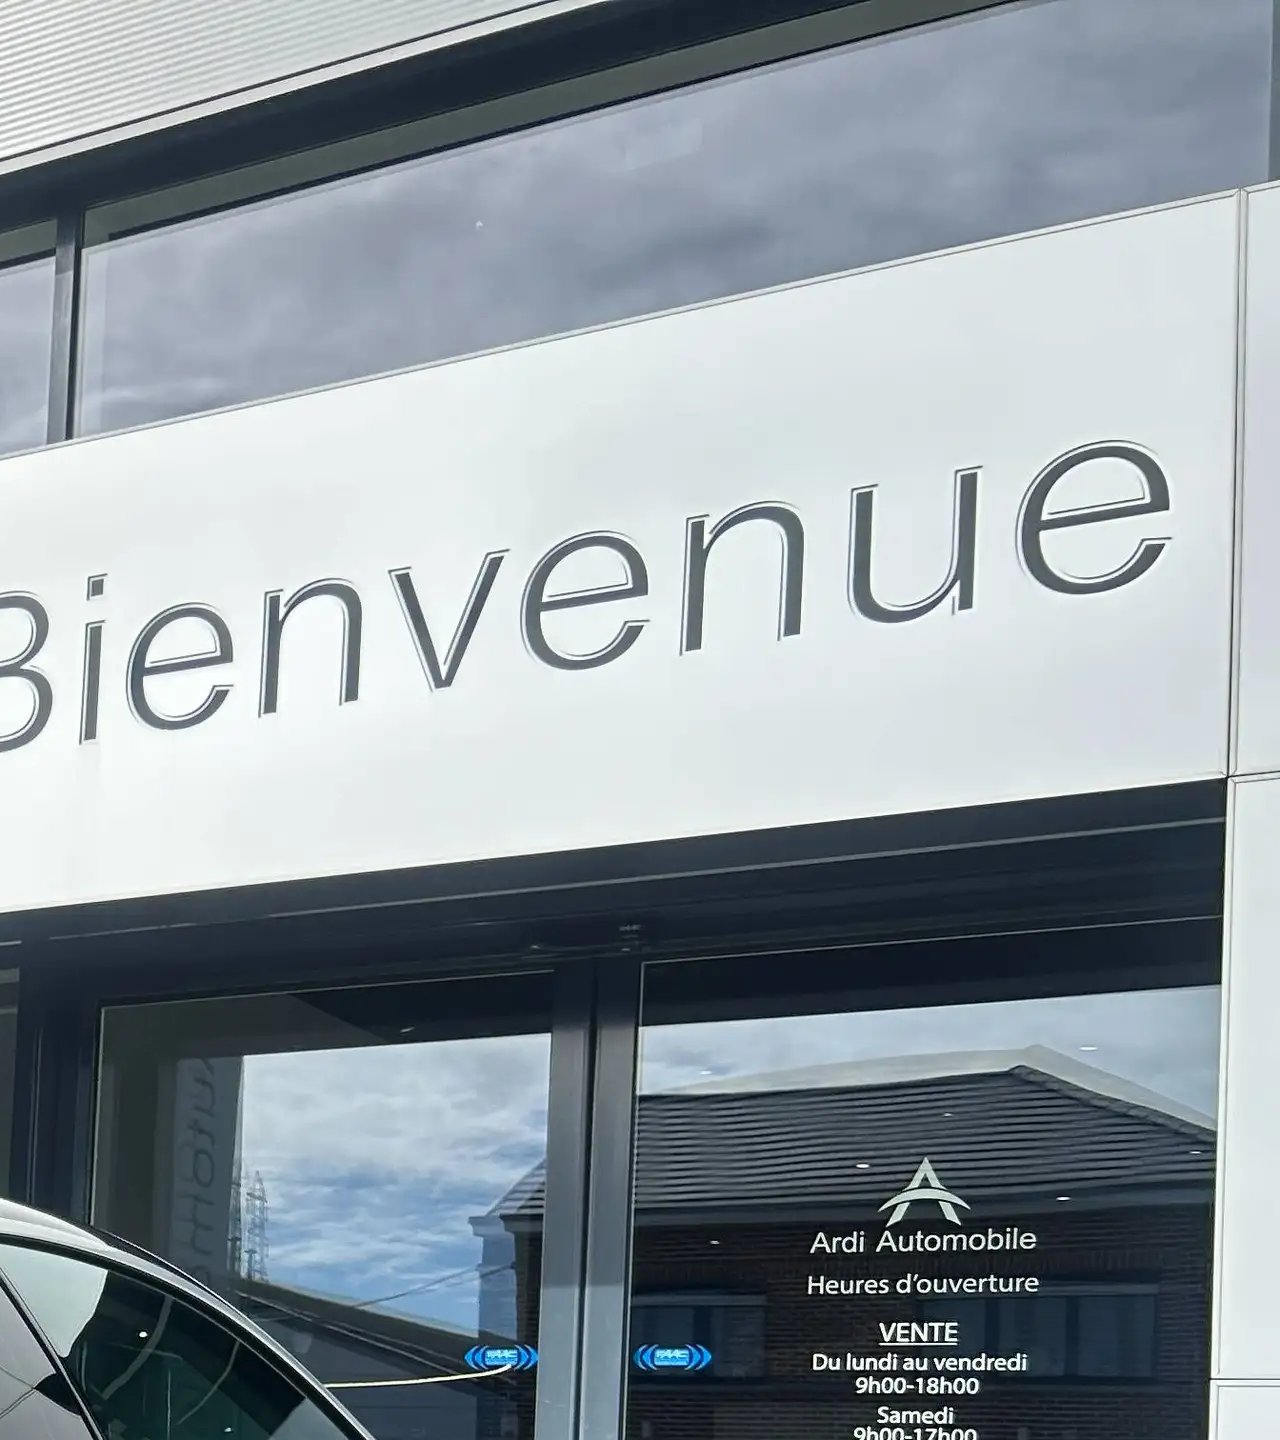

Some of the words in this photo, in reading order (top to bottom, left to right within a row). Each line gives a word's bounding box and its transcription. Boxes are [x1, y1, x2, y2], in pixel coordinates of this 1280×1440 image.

[809, 1230, 865, 1254] Ardi
[875, 1227, 1037, 1253] Automobile
[807, 1275, 890, 1295] Heures
[895, 1273, 1040, 1294] d'ouverture
[878, 1322, 959, 1343] VENTE
[812, 1353, 841, 1371] Du
[846, 1352, 898, 1371] lundi
[902, 1357, 929, 1371] au
[933, 1352, 1028, 1371] vendredi
[855, 1375, 980, 1395] 9h00-18h00
[876, 1406, 954, 1425] Samedi
